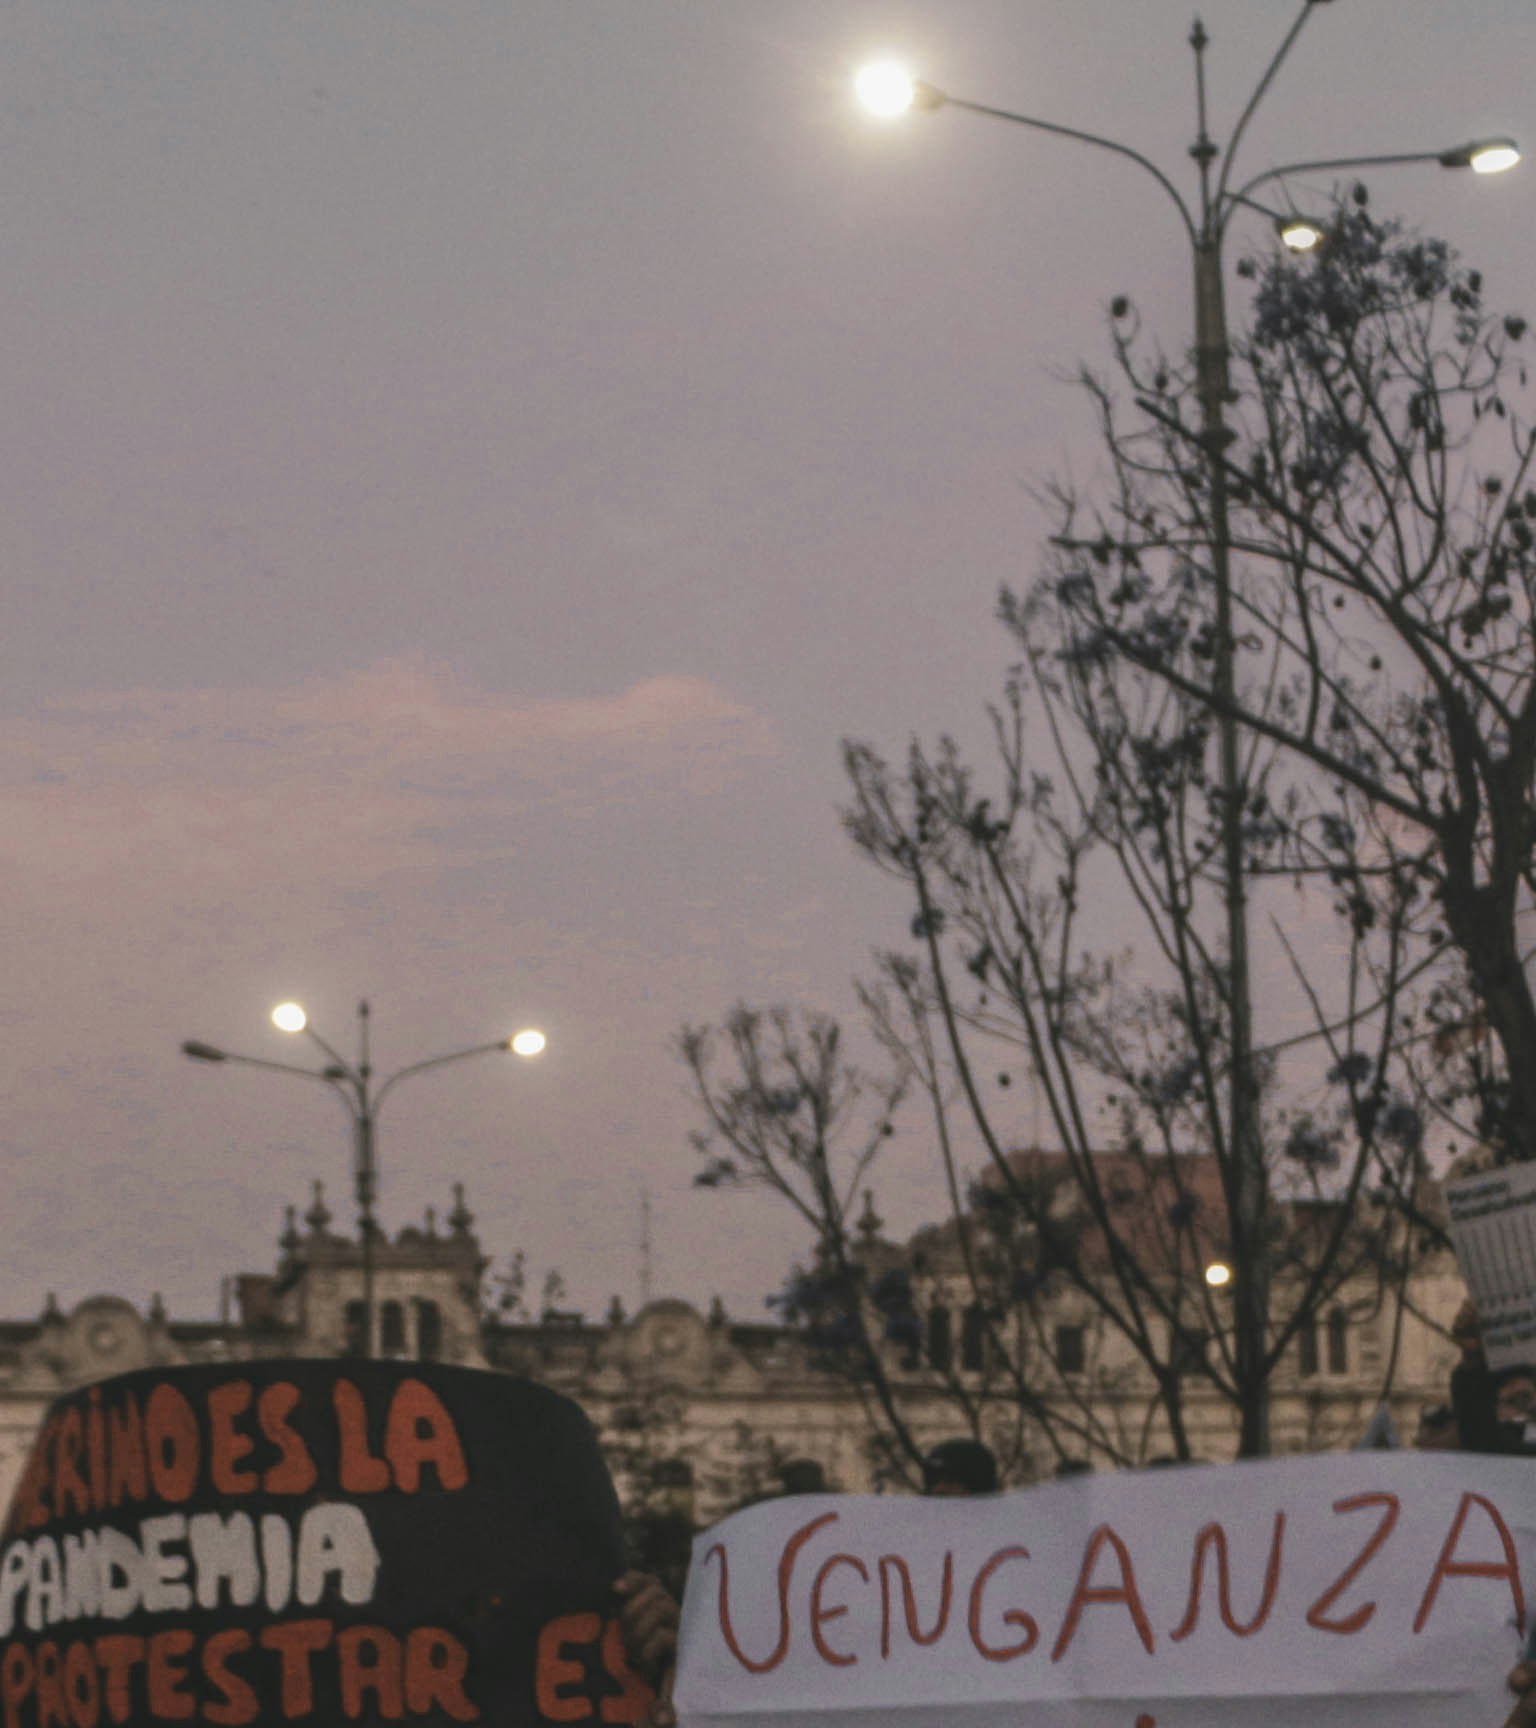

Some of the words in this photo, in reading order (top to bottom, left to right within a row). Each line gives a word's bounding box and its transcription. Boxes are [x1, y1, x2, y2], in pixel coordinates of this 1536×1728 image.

[209, 1379, 317, 1495] ES
[332, 1378, 468, 1494] LA
[704, 1491, 1526, 1675] VENGANZA
[534, 1611, 656, 1725] ES
